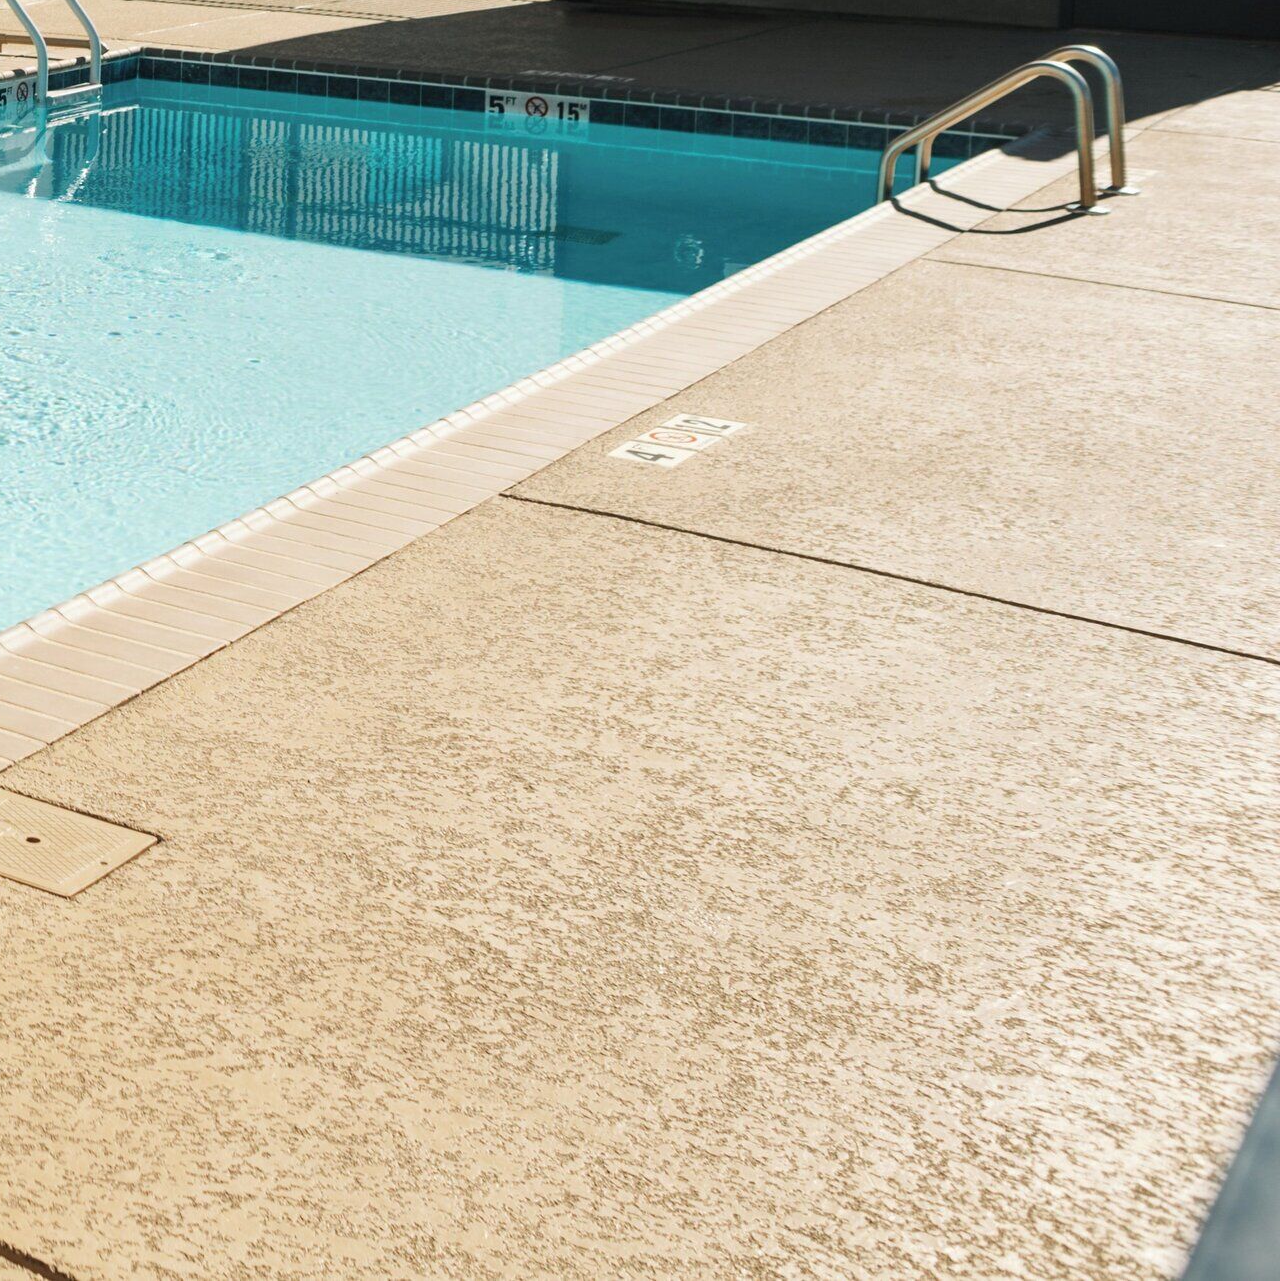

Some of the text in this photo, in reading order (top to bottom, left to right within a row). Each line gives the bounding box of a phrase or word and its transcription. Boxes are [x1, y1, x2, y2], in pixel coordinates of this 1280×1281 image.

[488, 95, 505, 114] 5
[505, 96, 517, 106] FT
[557, 101, 580, 121] 15
[626, 449, 675, 462] 4
